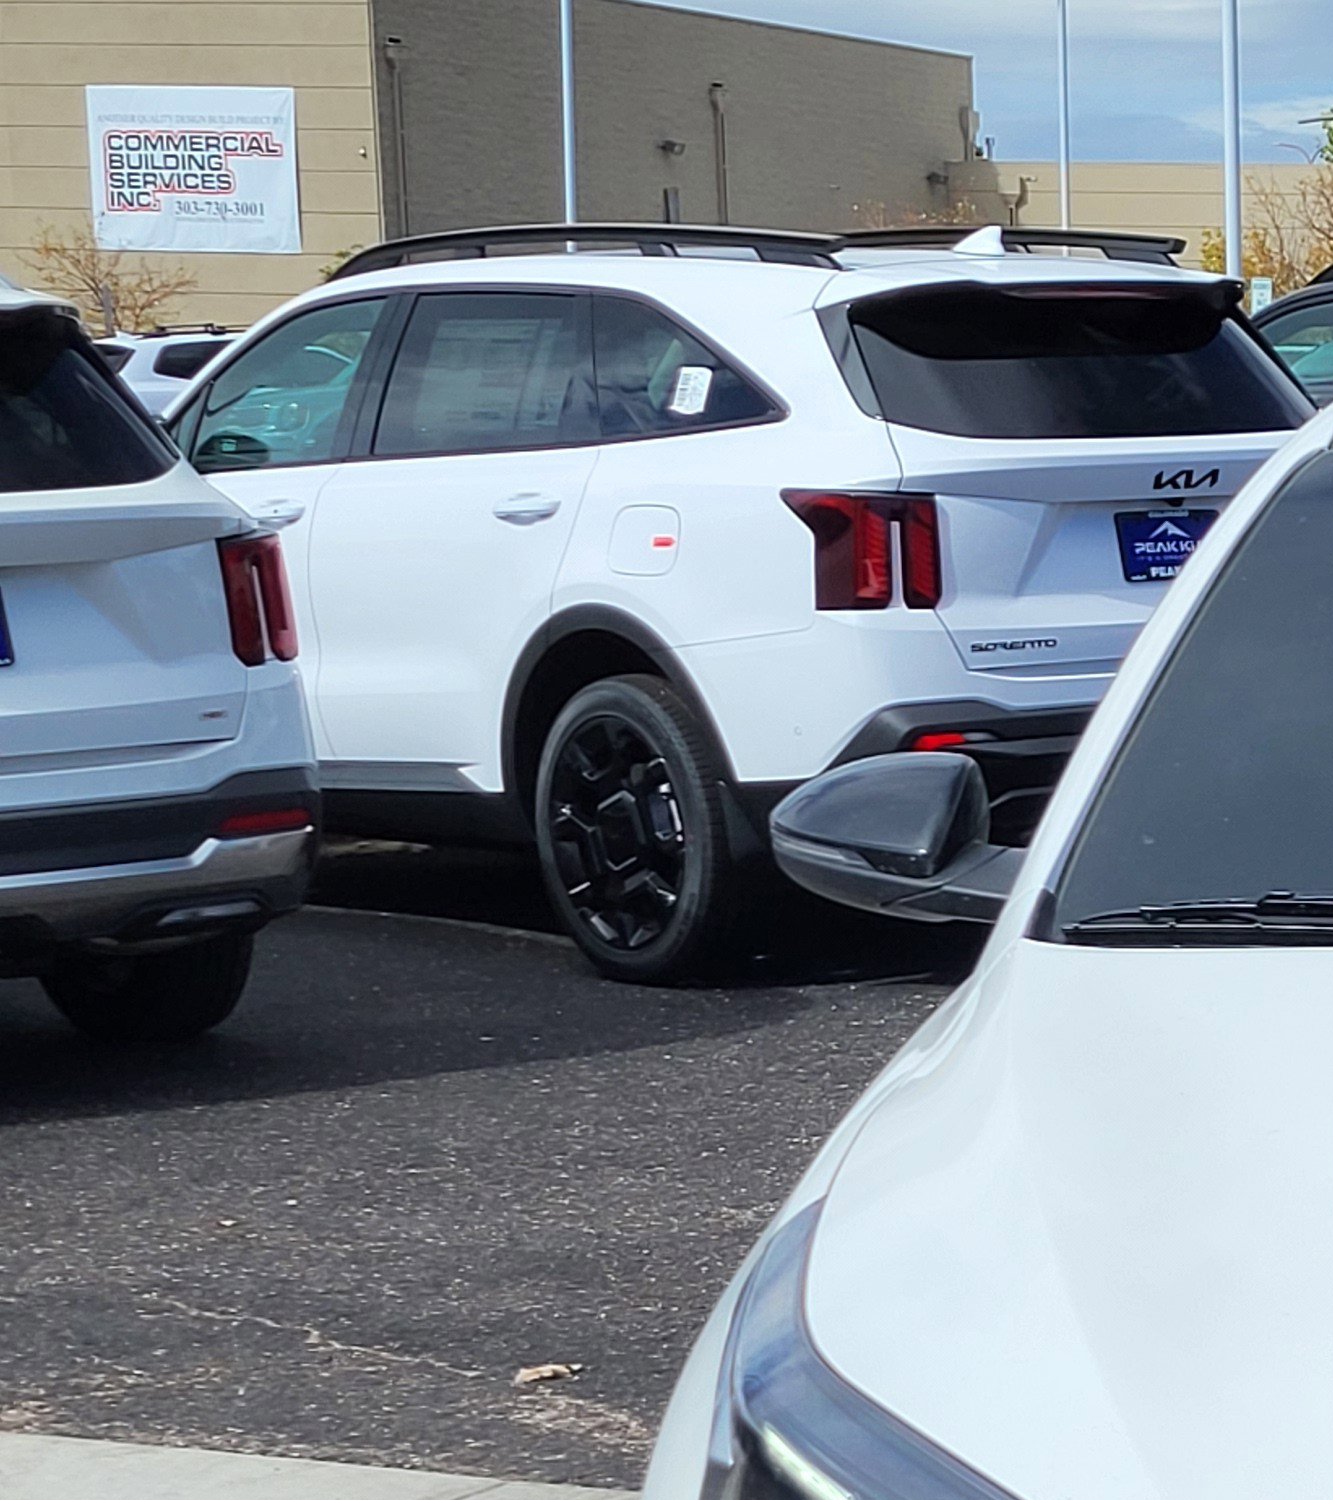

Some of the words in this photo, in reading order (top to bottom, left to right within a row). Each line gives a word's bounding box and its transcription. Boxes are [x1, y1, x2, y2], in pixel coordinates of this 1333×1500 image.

[107, 134, 279, 153] COMMERCIAL
[109, 153, 224, 171] BUILDING
[109, 172, 232, 190] SERVICES
[110, 191, 158, 208] INC.
[174, 200, 265, 217] 303-730-3001
[1134, 541, 1179, 554] PEAK
[970, 639, 1058, 653] SORENTO
